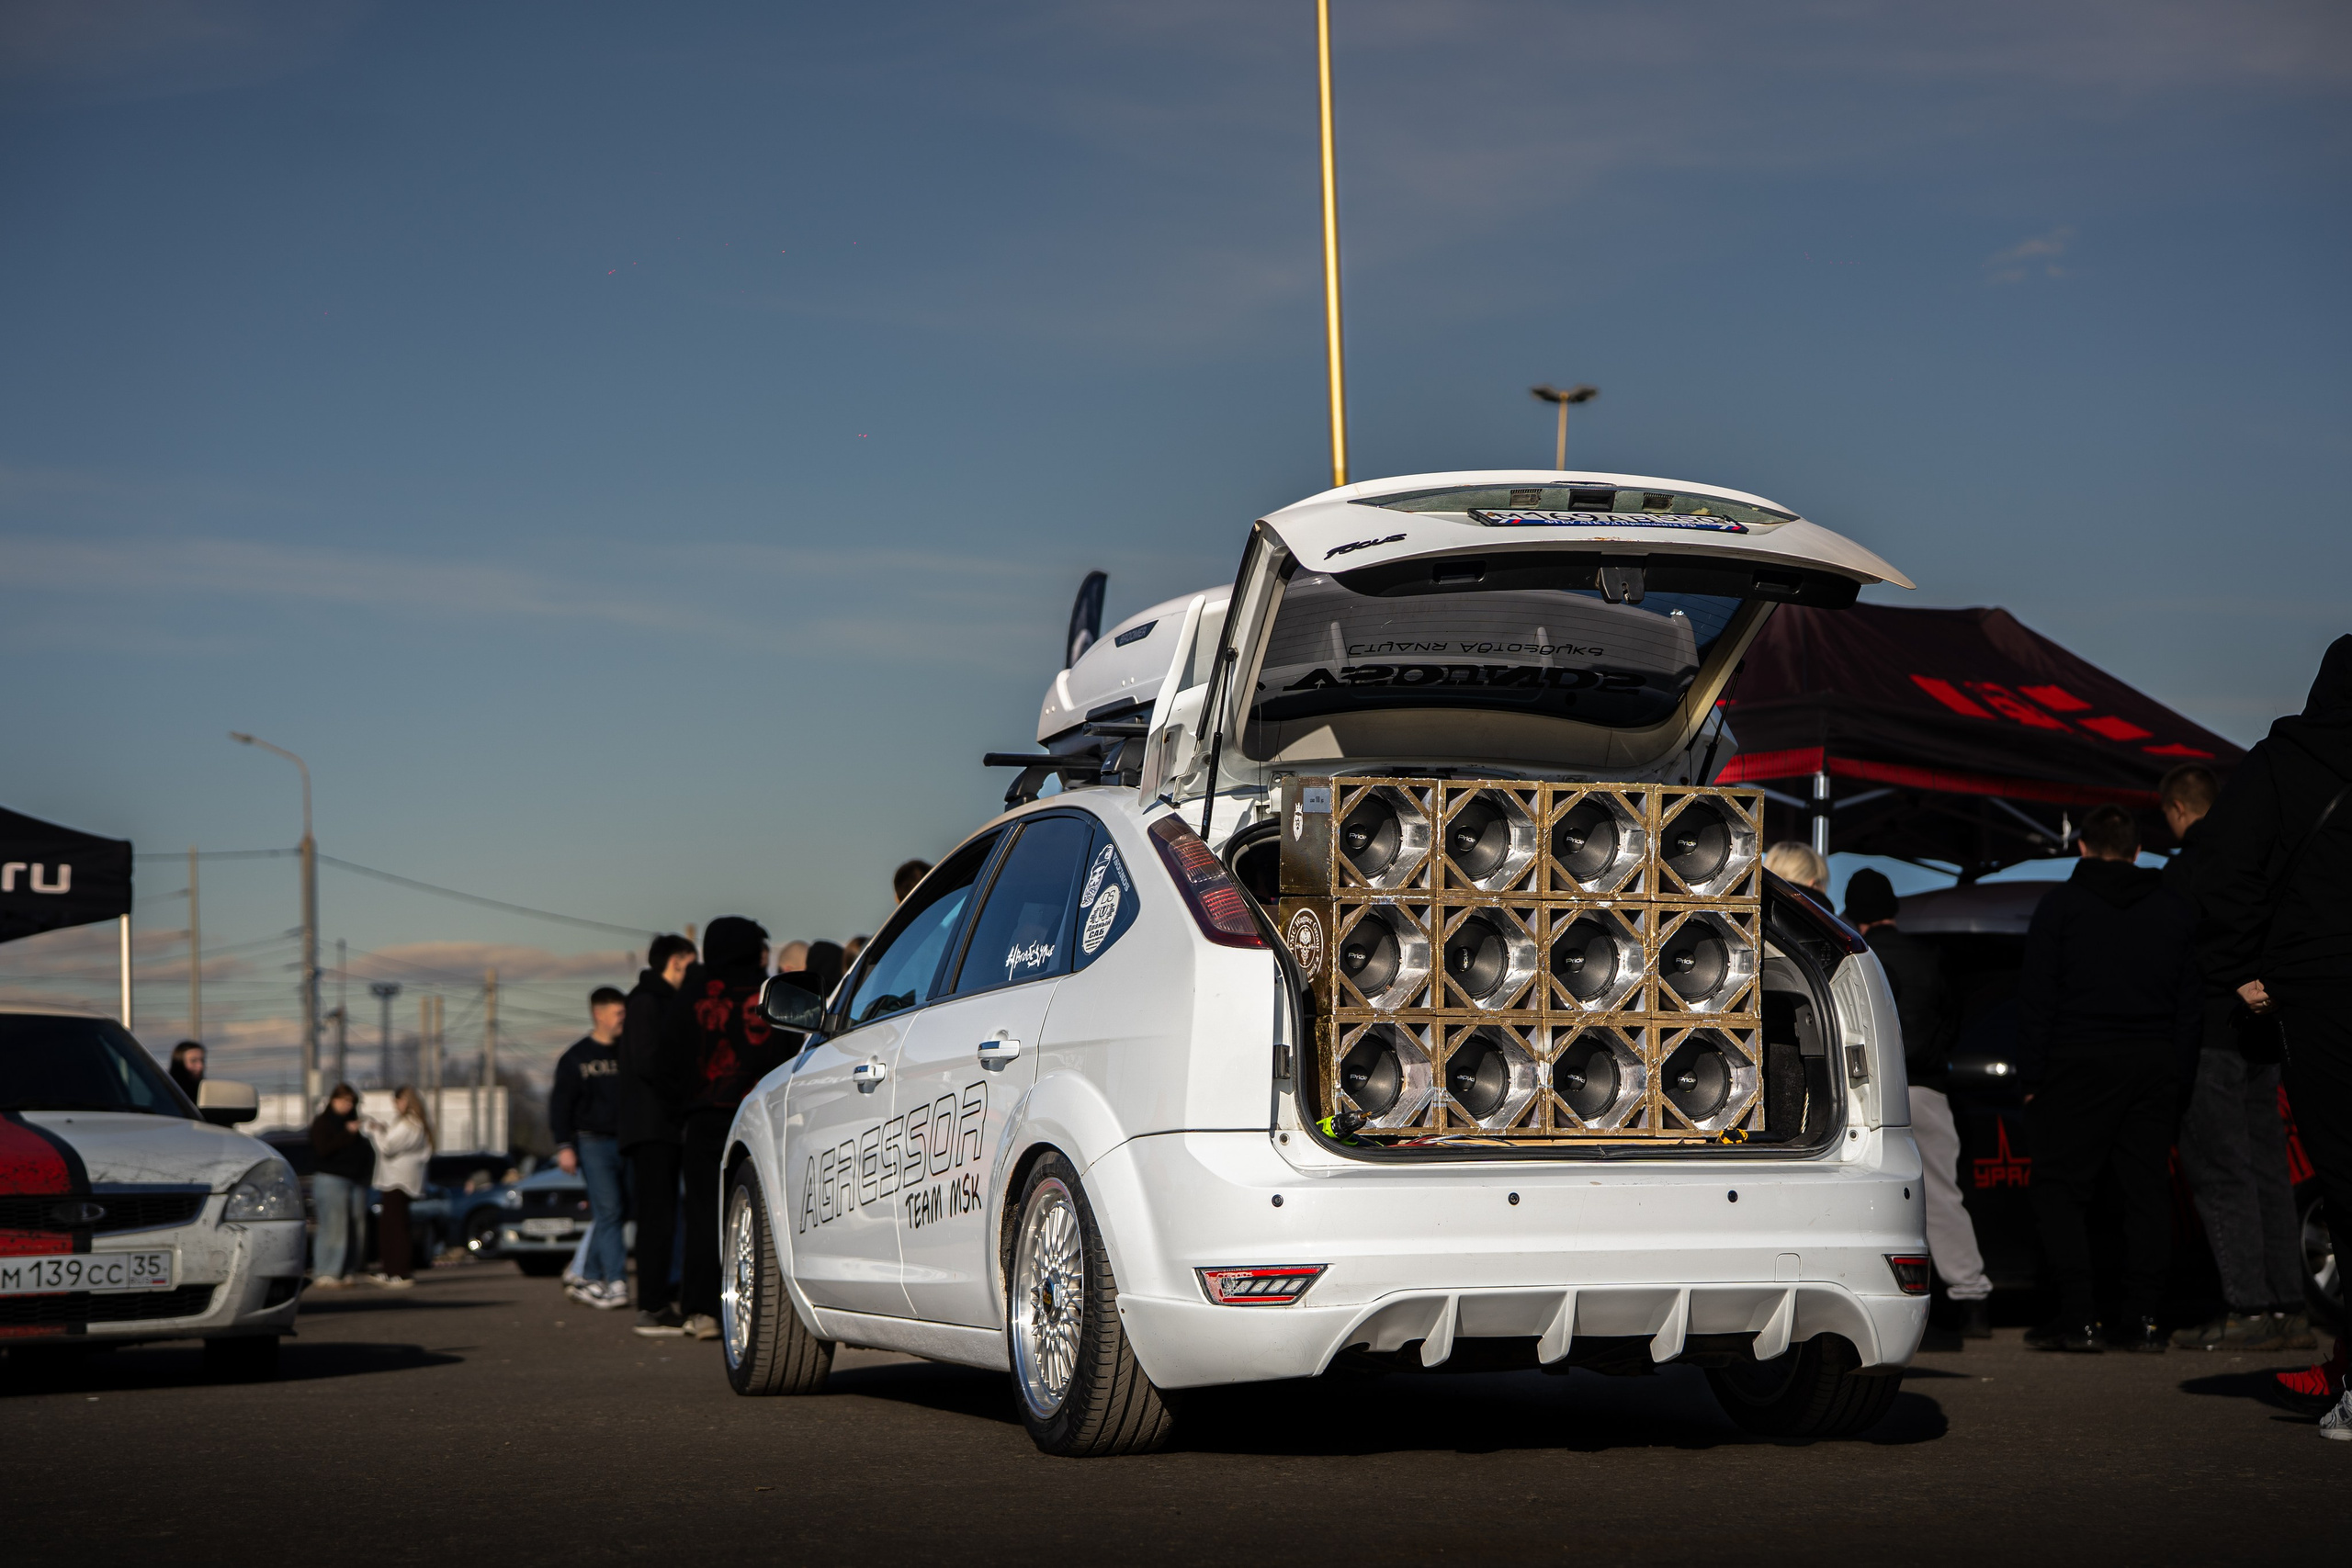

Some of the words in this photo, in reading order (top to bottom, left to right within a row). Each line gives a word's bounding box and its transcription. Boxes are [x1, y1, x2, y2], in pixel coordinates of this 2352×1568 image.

[1349, 832, 1367, 840] Pride
[1457, 835, 1476, 843] Pride
[1566, 837, 1585, 845] Pride
[2, 862, 73, 894] ru
[1348, 952, 1366, 960] Pride
[1457, 1075, 1476, 1083] Pride
[1567, 1074, 1586, 1084] Pride
[1678, 1076, 1697, 1084] Pride
[799, 1080, 989, 1235] AGRESSOR
[905, 1183, 944, 1230] TEAM
[949, 1172, 982, 1217] MSK
[132, 1255, 162, 1276] 35
